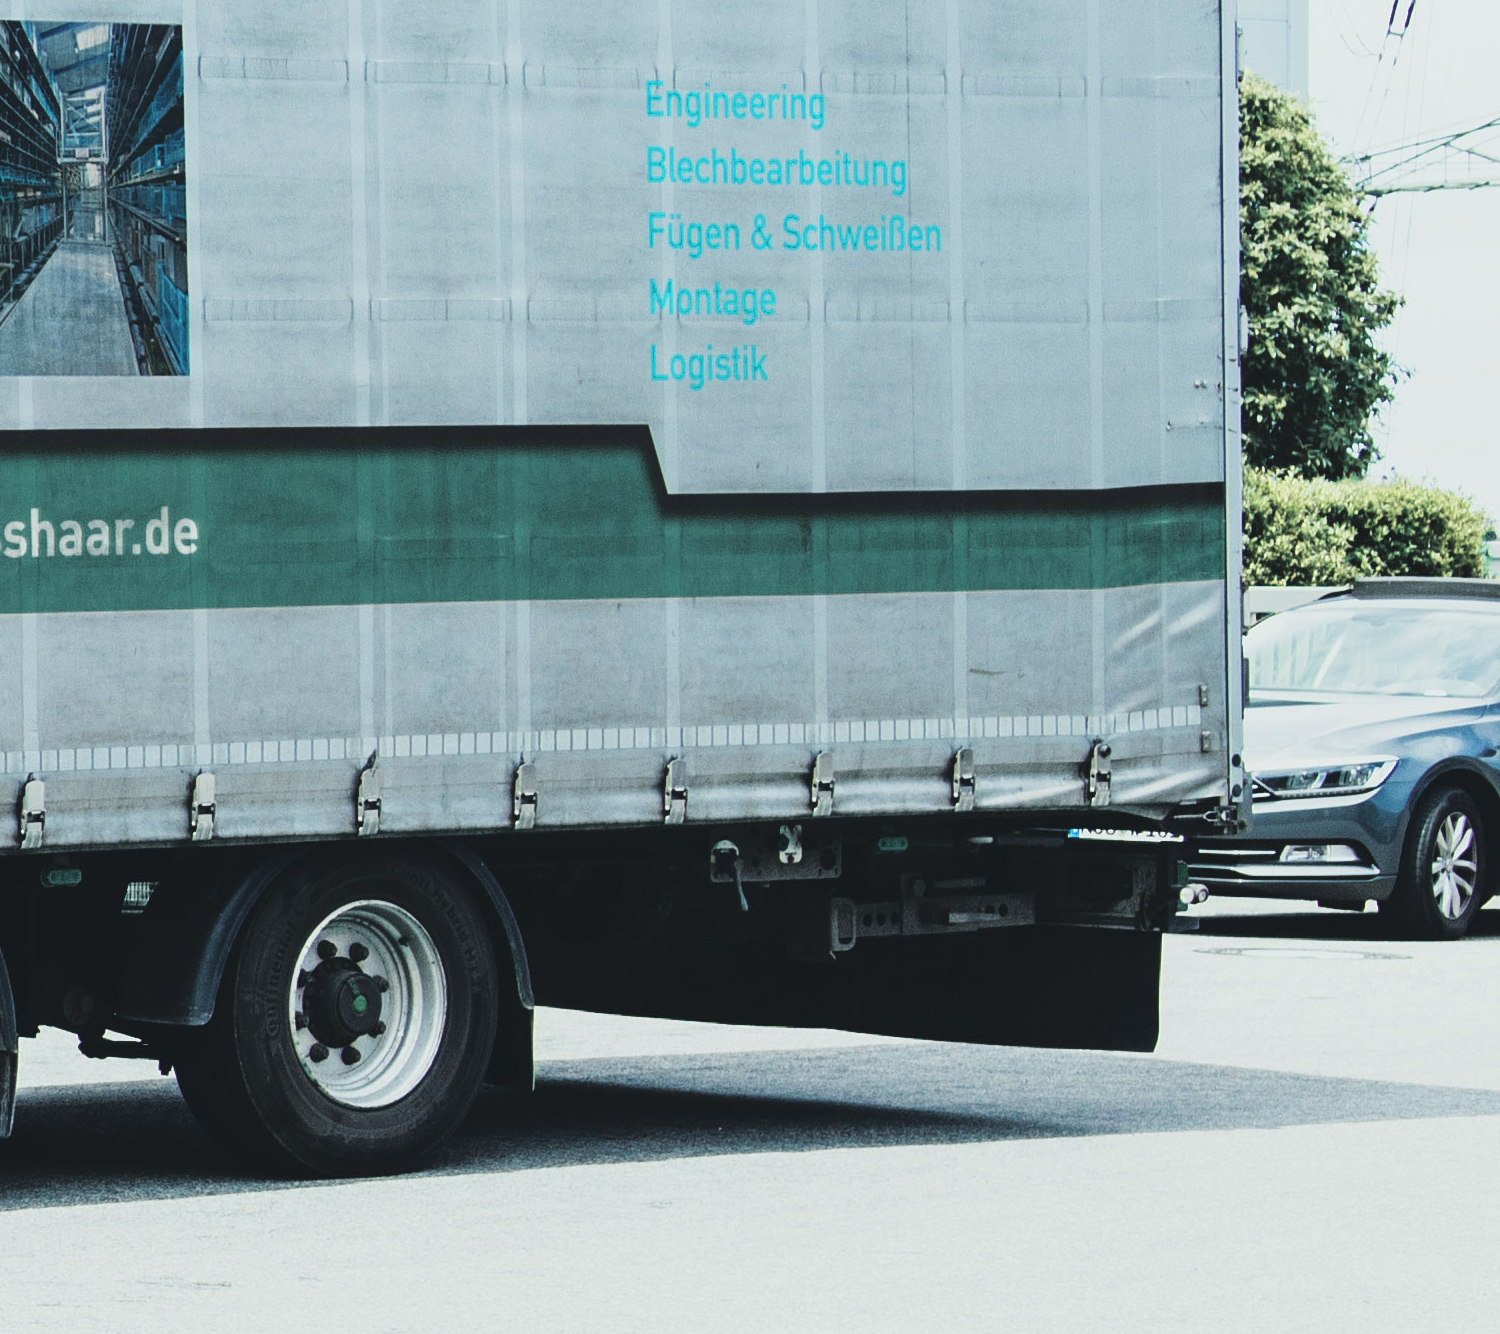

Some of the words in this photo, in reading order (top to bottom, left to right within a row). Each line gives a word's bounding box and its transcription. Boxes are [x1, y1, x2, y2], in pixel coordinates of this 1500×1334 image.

[646, 80, 825, 130] Engineering
[647, 146, 906, 197] Blechbearbeitung
[649, 212, 741, 260] Fügen
[751, 213, 773, 251] &
[782, 213, 942, 252] Schweißen
[649, 278, 776, 325] Montage
[650, 344, 768, 391] Logistik
